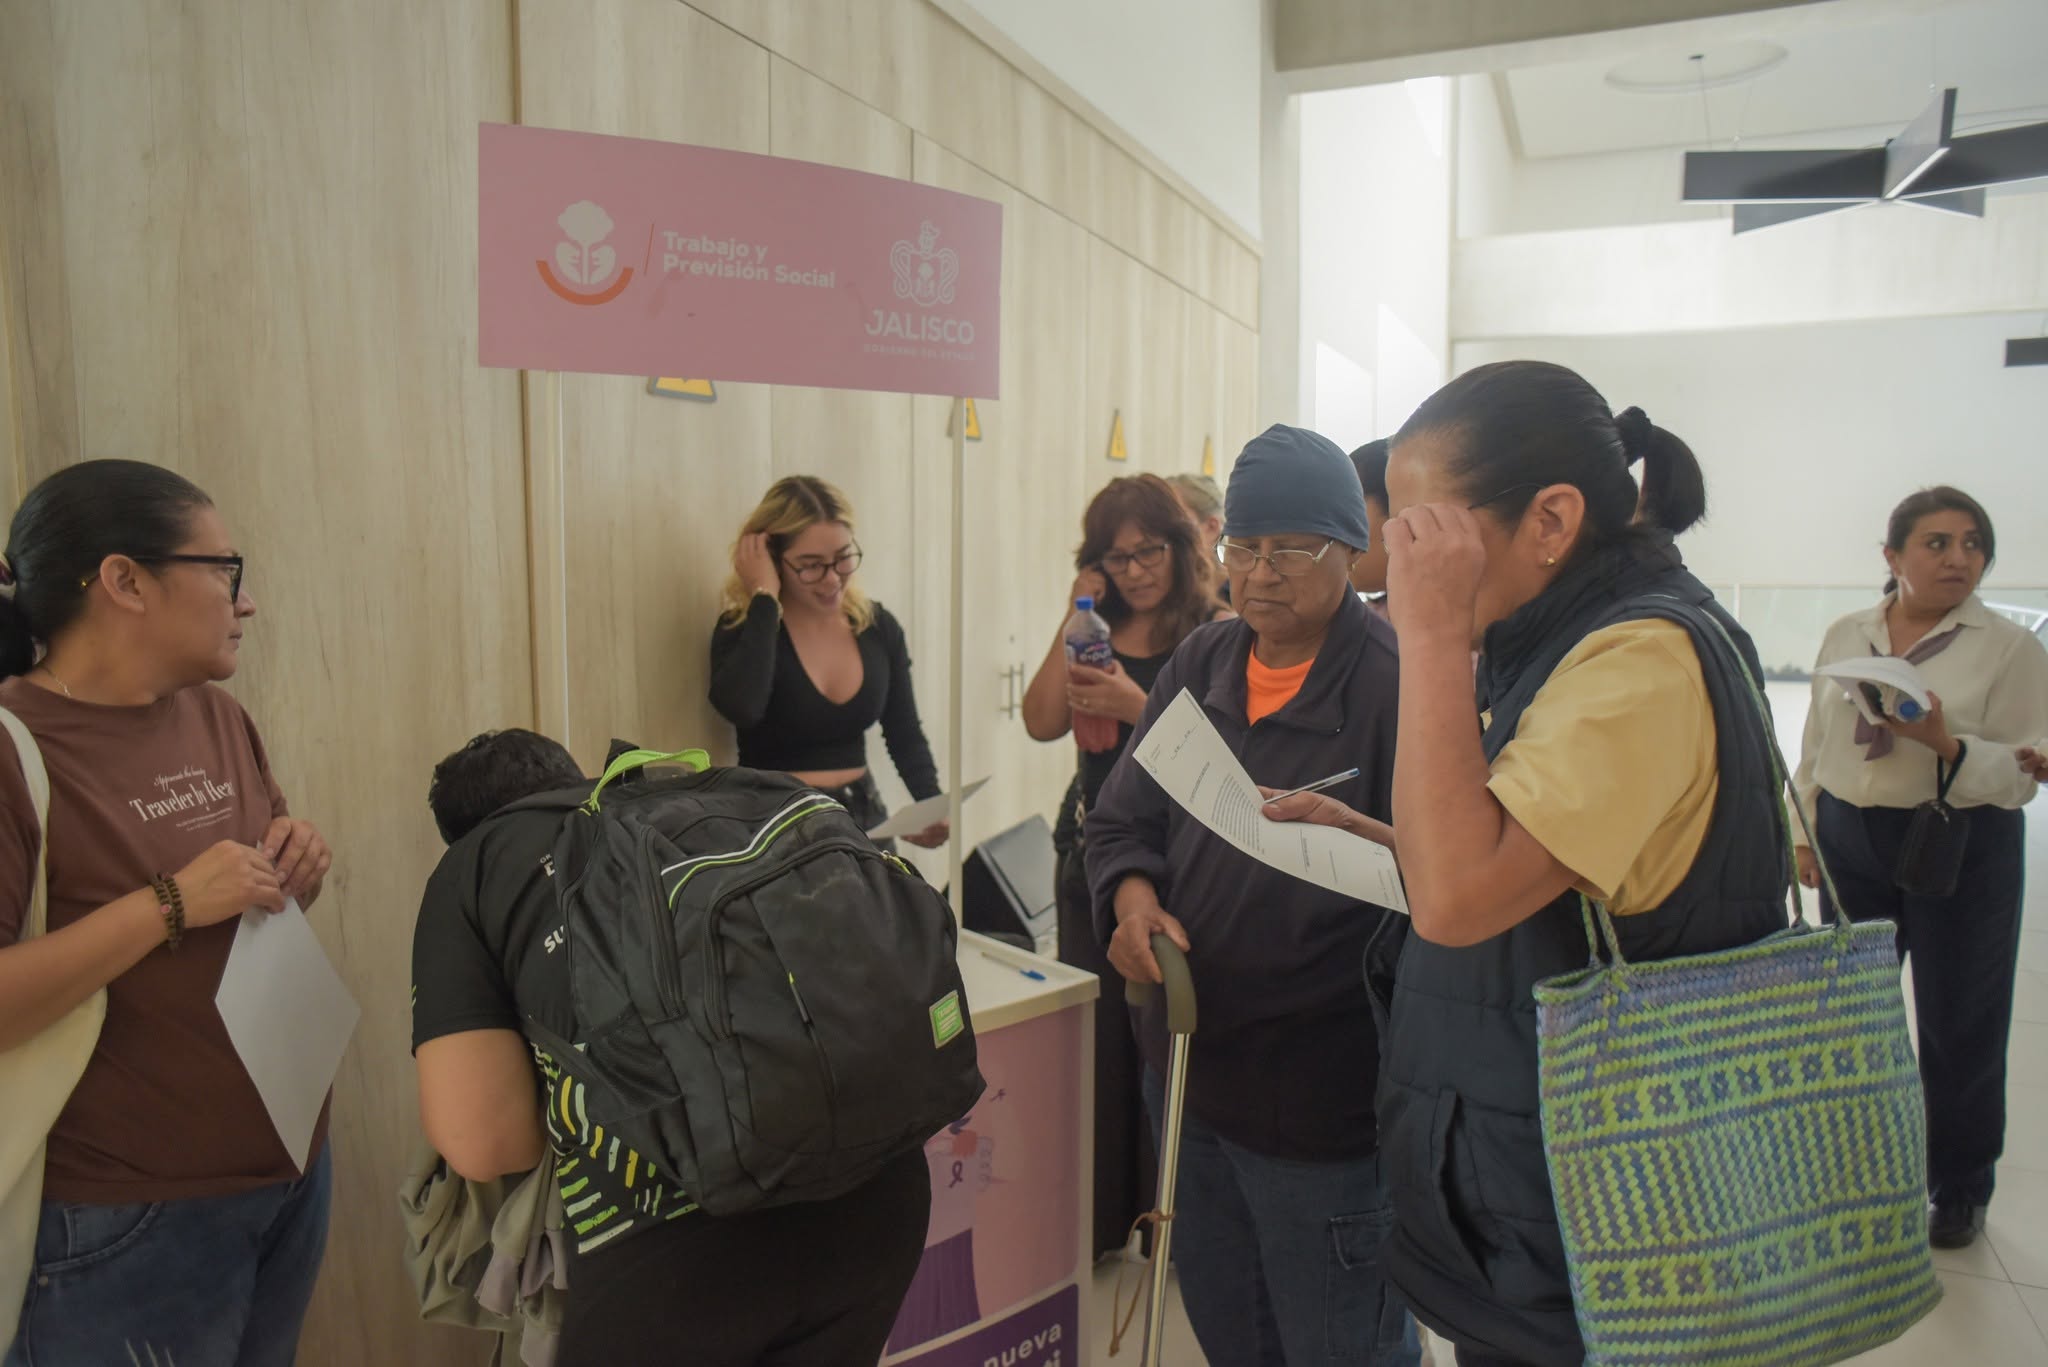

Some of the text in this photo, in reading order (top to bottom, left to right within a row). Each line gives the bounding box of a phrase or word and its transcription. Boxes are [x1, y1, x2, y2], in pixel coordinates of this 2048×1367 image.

[663, 231, 768, 264] Trabajo y
[663, 253, 836, 289] Previsión Social
[864, 308, 976, 344] JALISCO
[129, 788, 195, 821] Traveler
[189, 783, 210, 811] by
[544, 925, 564, 953] SU
[984, 1322, 1063, 1367] nueva
